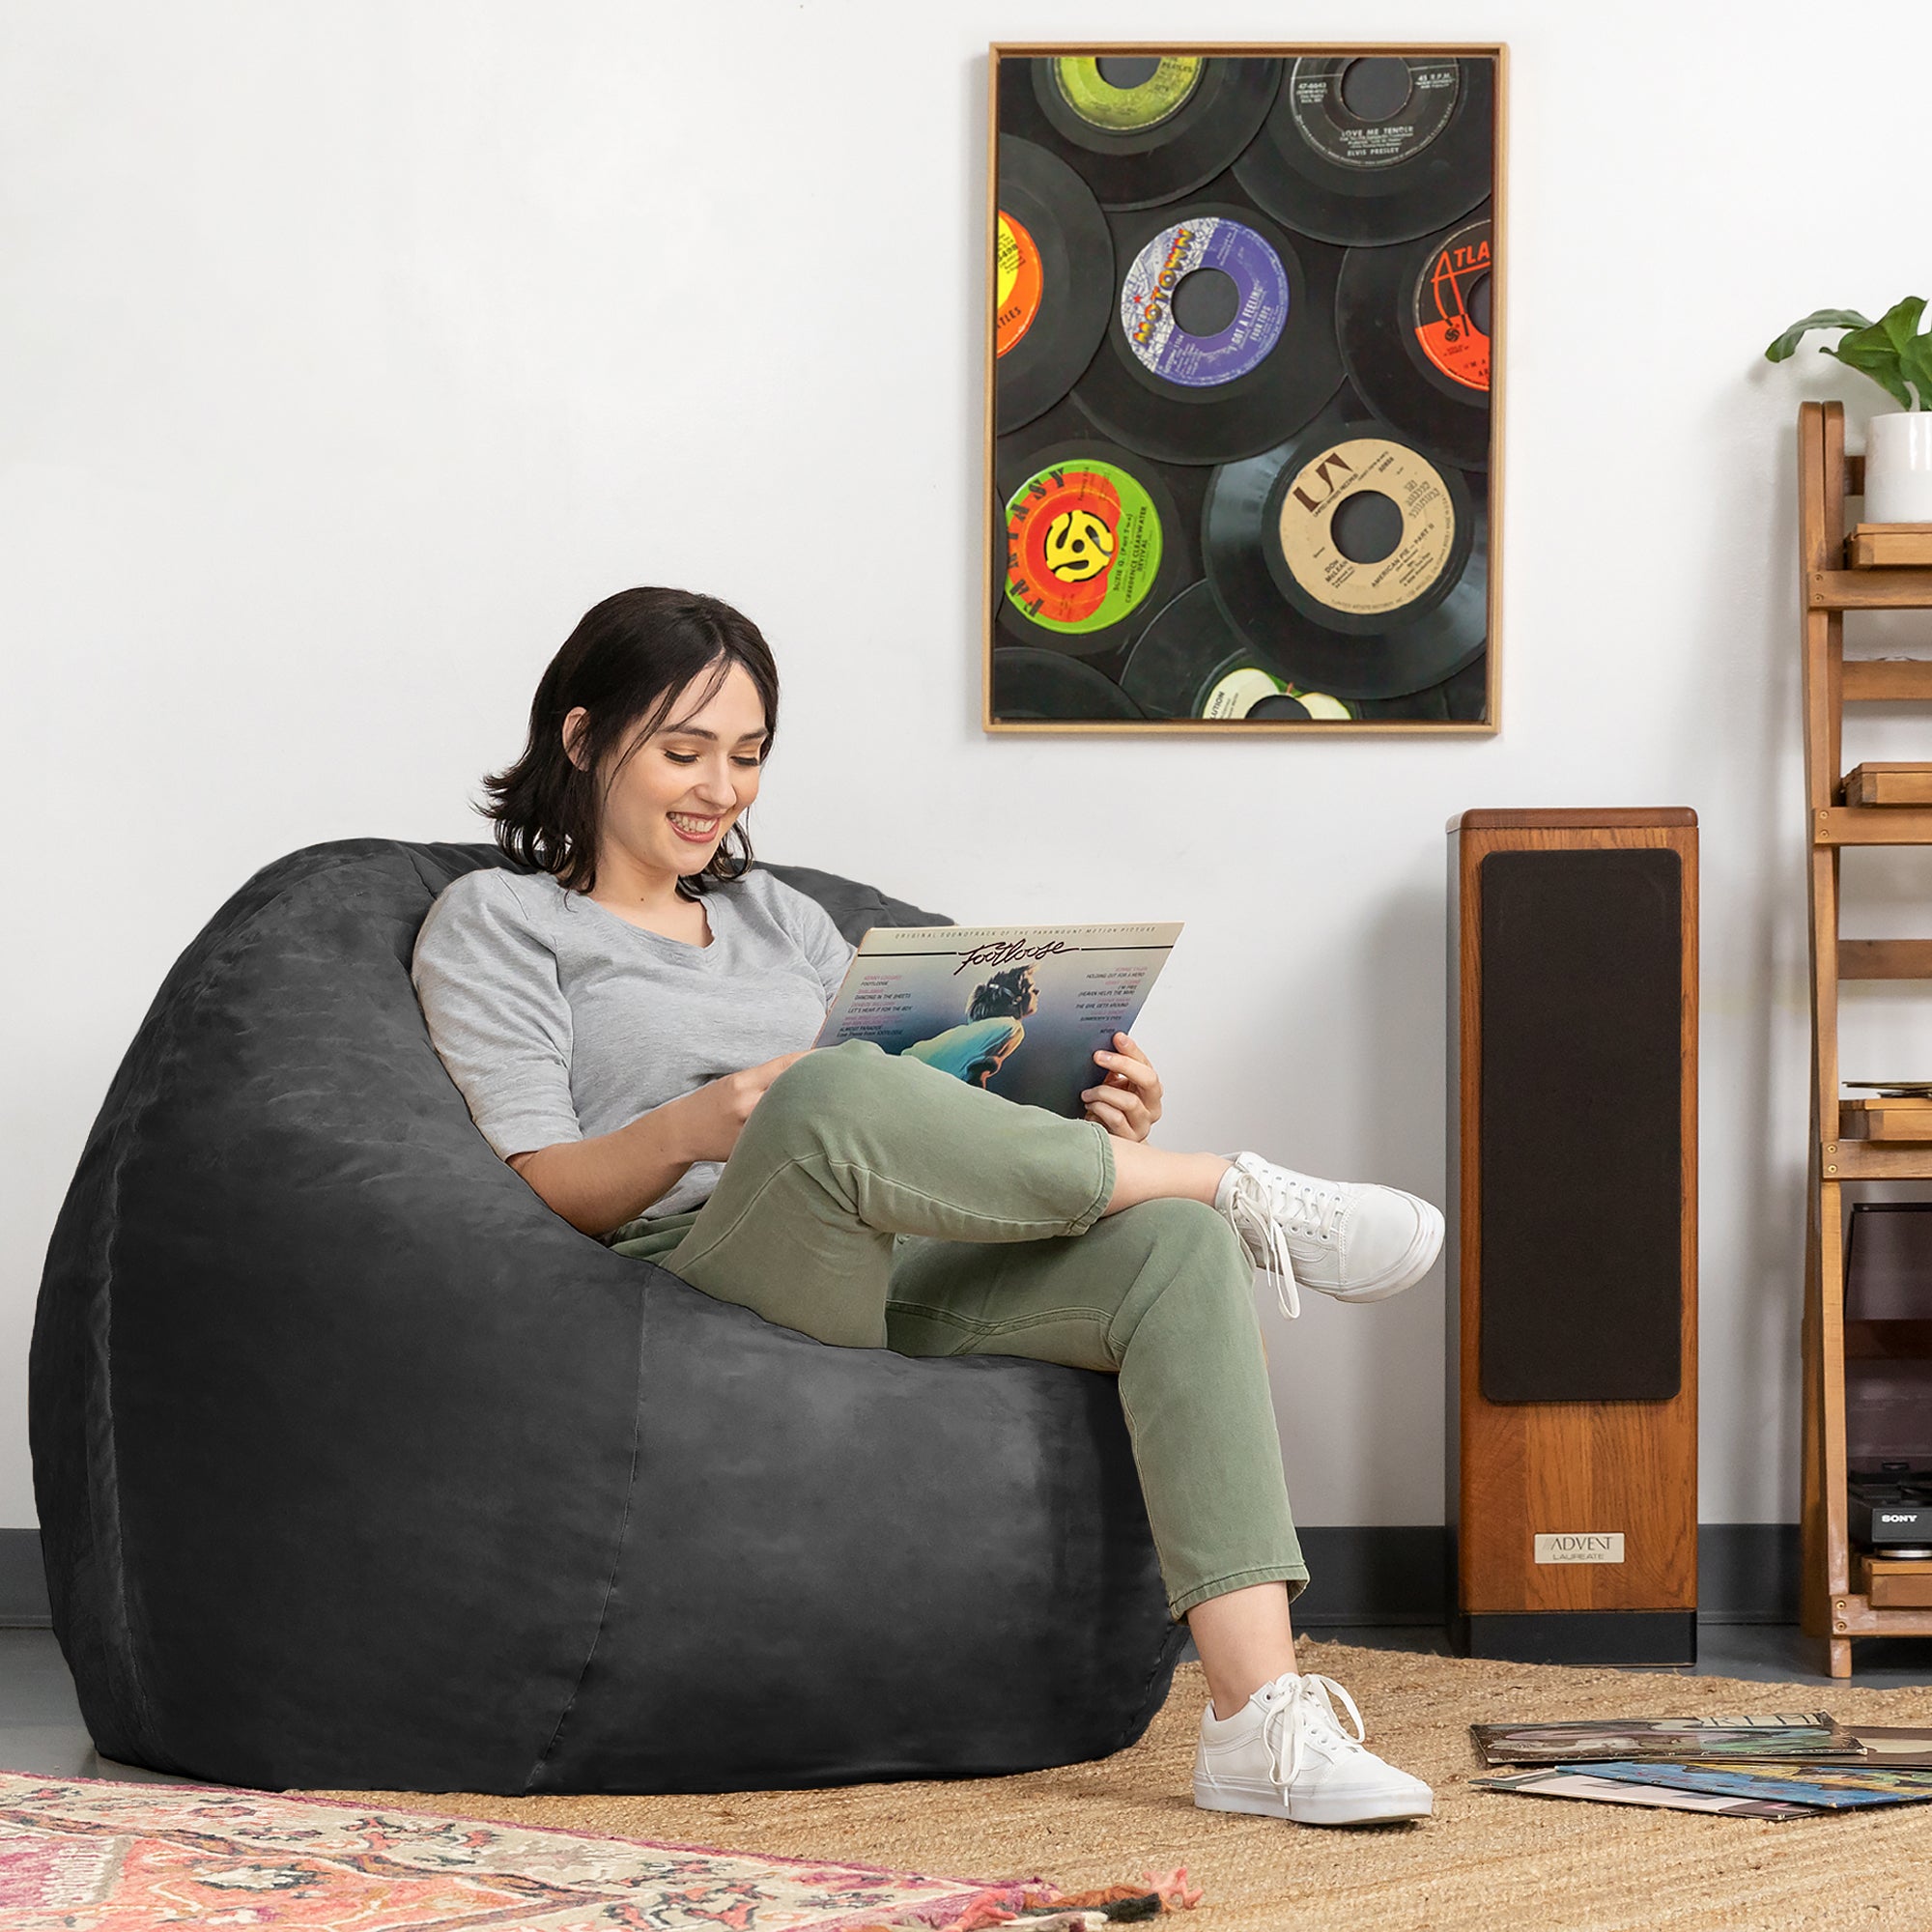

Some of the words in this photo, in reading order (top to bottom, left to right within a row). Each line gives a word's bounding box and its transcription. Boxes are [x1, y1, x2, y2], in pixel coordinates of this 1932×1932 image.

[1133, 228, 1195, 348] MOTOWN
[1125, 560, 1137, 603] CREEDENCE
[1133, 506, 1147, 557] CLEARWATER
[1137, 540, 1148, 572] REVIVAL
[1324, 559, 1339, 573] DON
[1325, 560, 1348, 582] McLEAN
[1372, 556, 1401, 587] AMERICAN
[1399, 548, 1410, 558] PIE
[1414, 527, 1430, 544] PART
[953, 938, 1080, 976] Footloose
[1550, 1537, 1613, 1550] ADVENT
